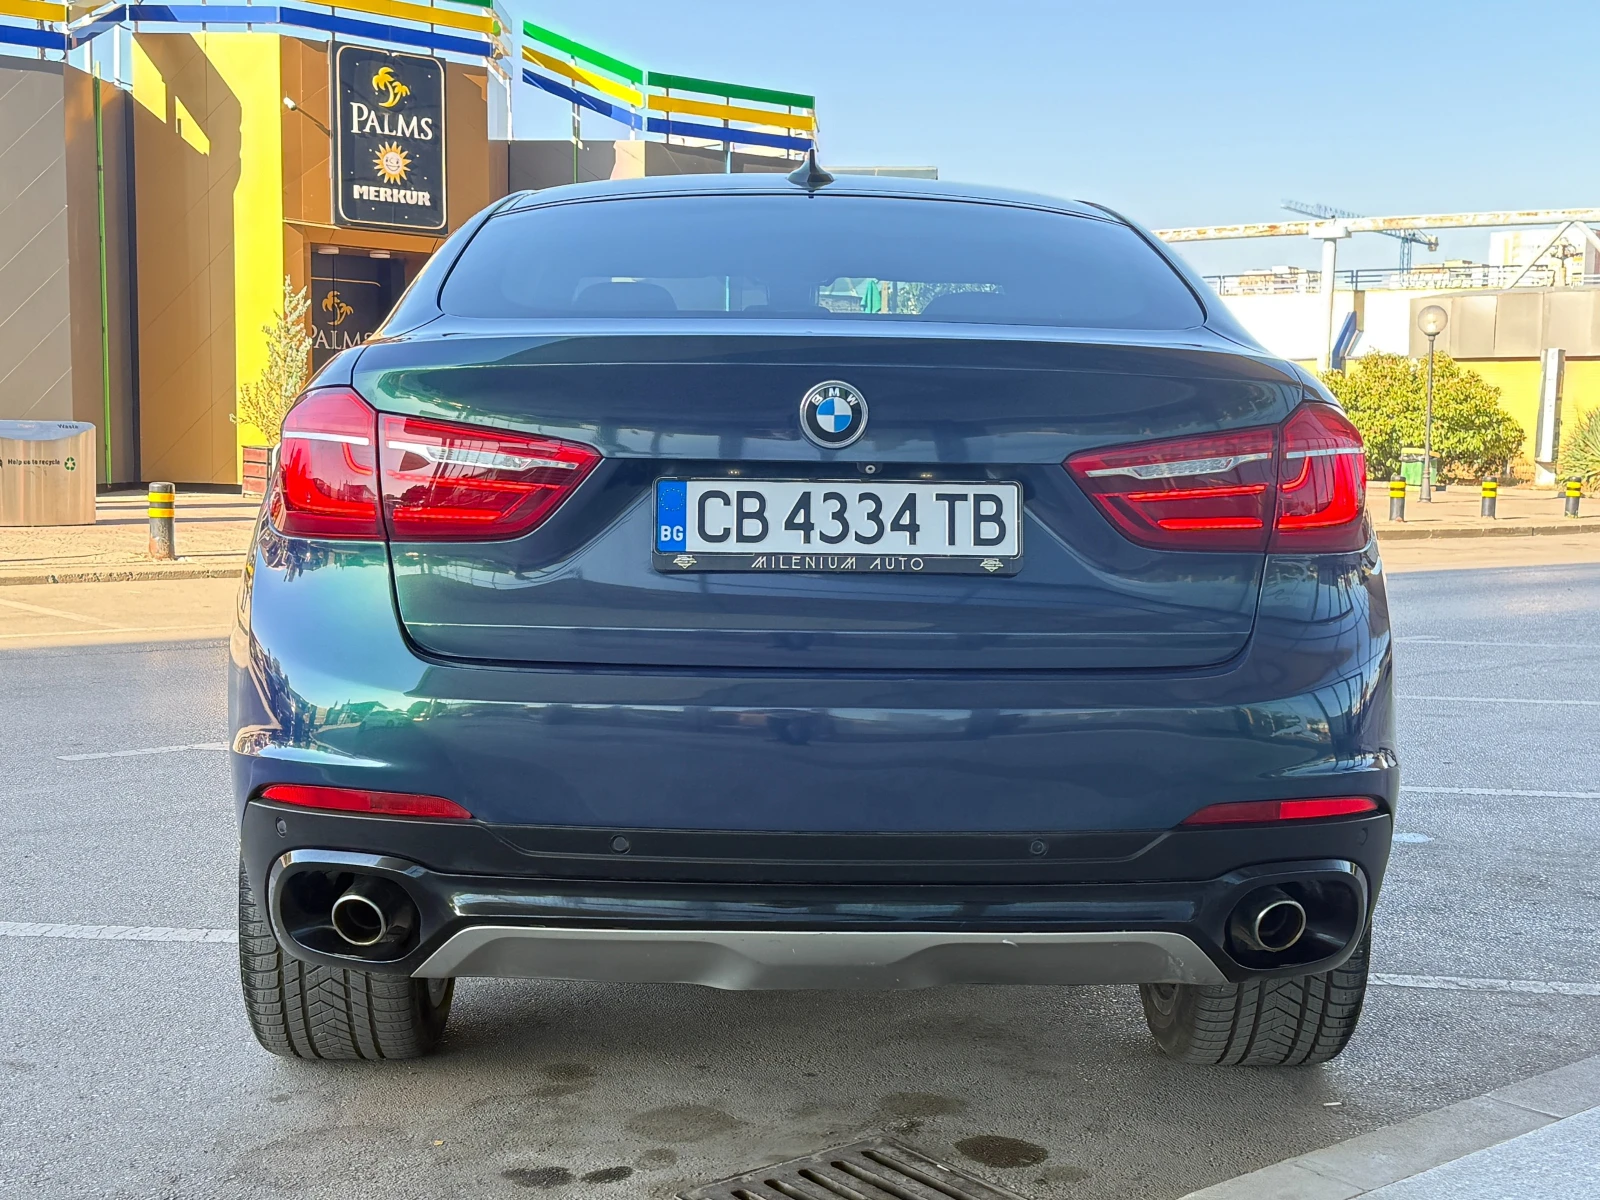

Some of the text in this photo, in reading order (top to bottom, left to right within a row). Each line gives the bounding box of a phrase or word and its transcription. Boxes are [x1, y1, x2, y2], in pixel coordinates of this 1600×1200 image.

[350, 102, 433, 140] PALMS
[353, 184, 431, 207] MERKUR
[811, 387, 859, 406] BMW
[697, 490, 1007, 547] CB 4334 TB
[660, 525, 684, 543] BG
[751, 556, 924, 571] MILENIUM AUTO
